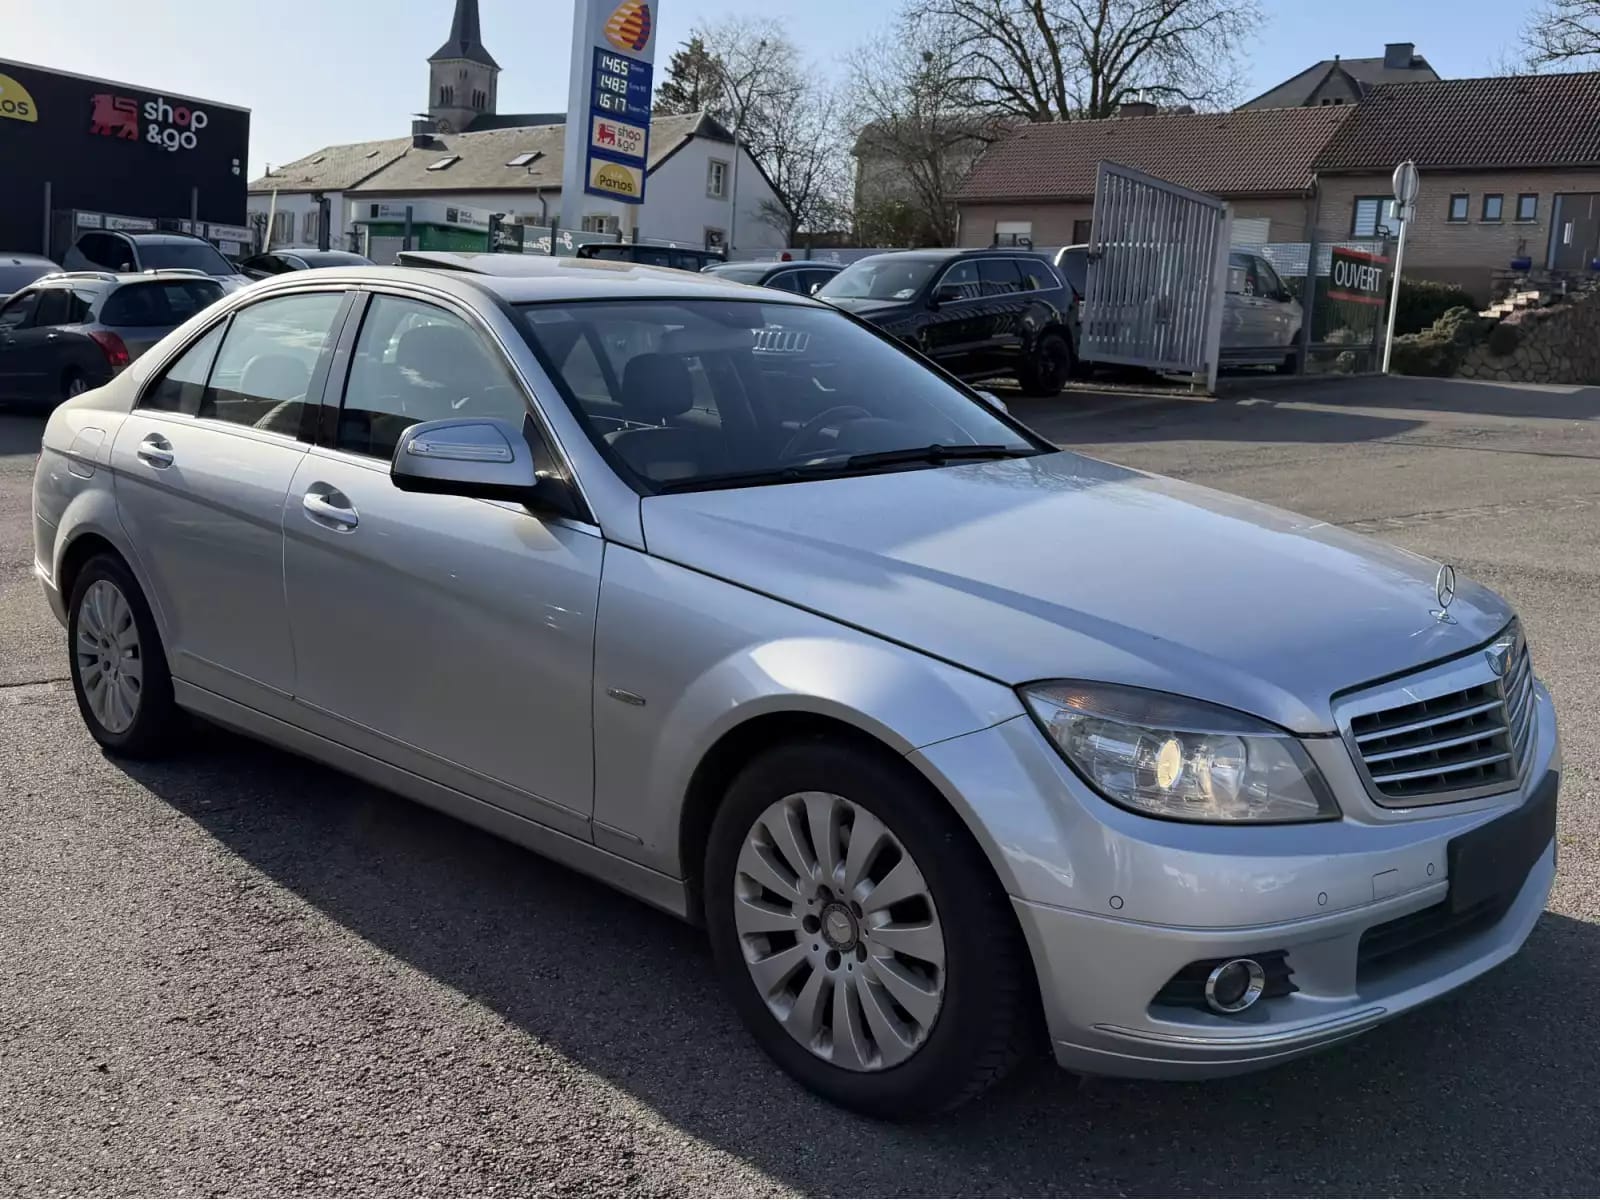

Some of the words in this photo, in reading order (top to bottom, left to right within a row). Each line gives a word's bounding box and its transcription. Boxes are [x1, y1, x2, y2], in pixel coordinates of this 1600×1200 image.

[143, 97, 208, 131] shop
[146, 124, 197, 152] &go
[617, 126, 641, 141] shop
[617, 138, 636, 152] &go
[599, 174, 632, 192] Panos
[1335, 260, 1383, 292] OUVERT
